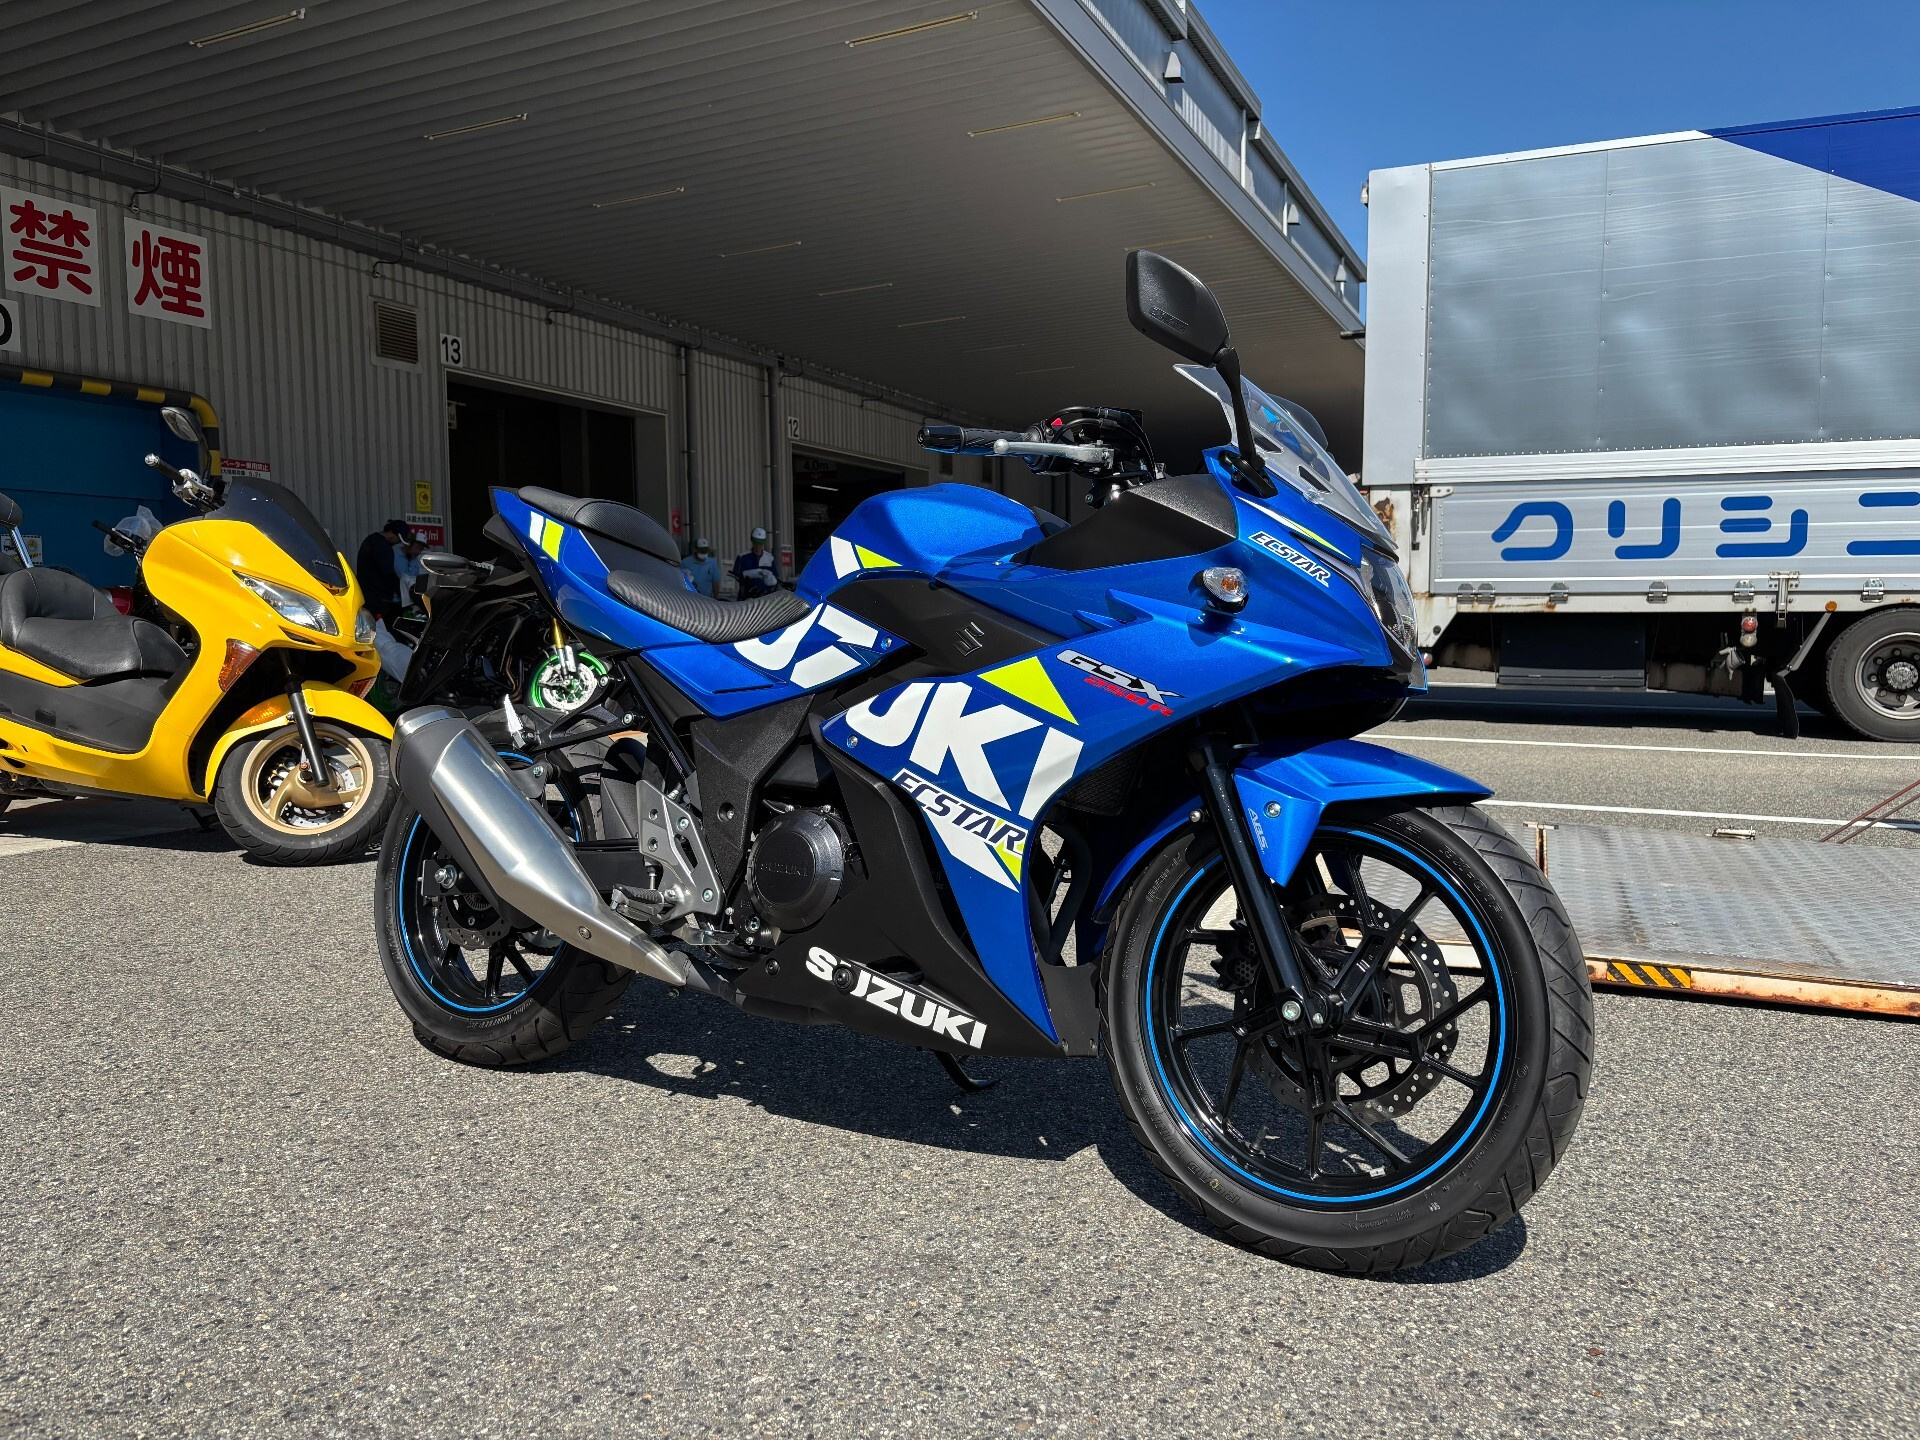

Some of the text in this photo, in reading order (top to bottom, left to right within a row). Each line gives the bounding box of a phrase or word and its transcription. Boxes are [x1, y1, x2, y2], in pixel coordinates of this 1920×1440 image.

[9, 199, 205, 318] 禁 煙
[441, 336, 461, 364] 13
[788, 418, 799, 438] 12
[1247, 530, 1331, 588] ECSTAR
[1056, 648, 1187, 706] GSX
[893, 768, 1028, 858] ECSTAR
